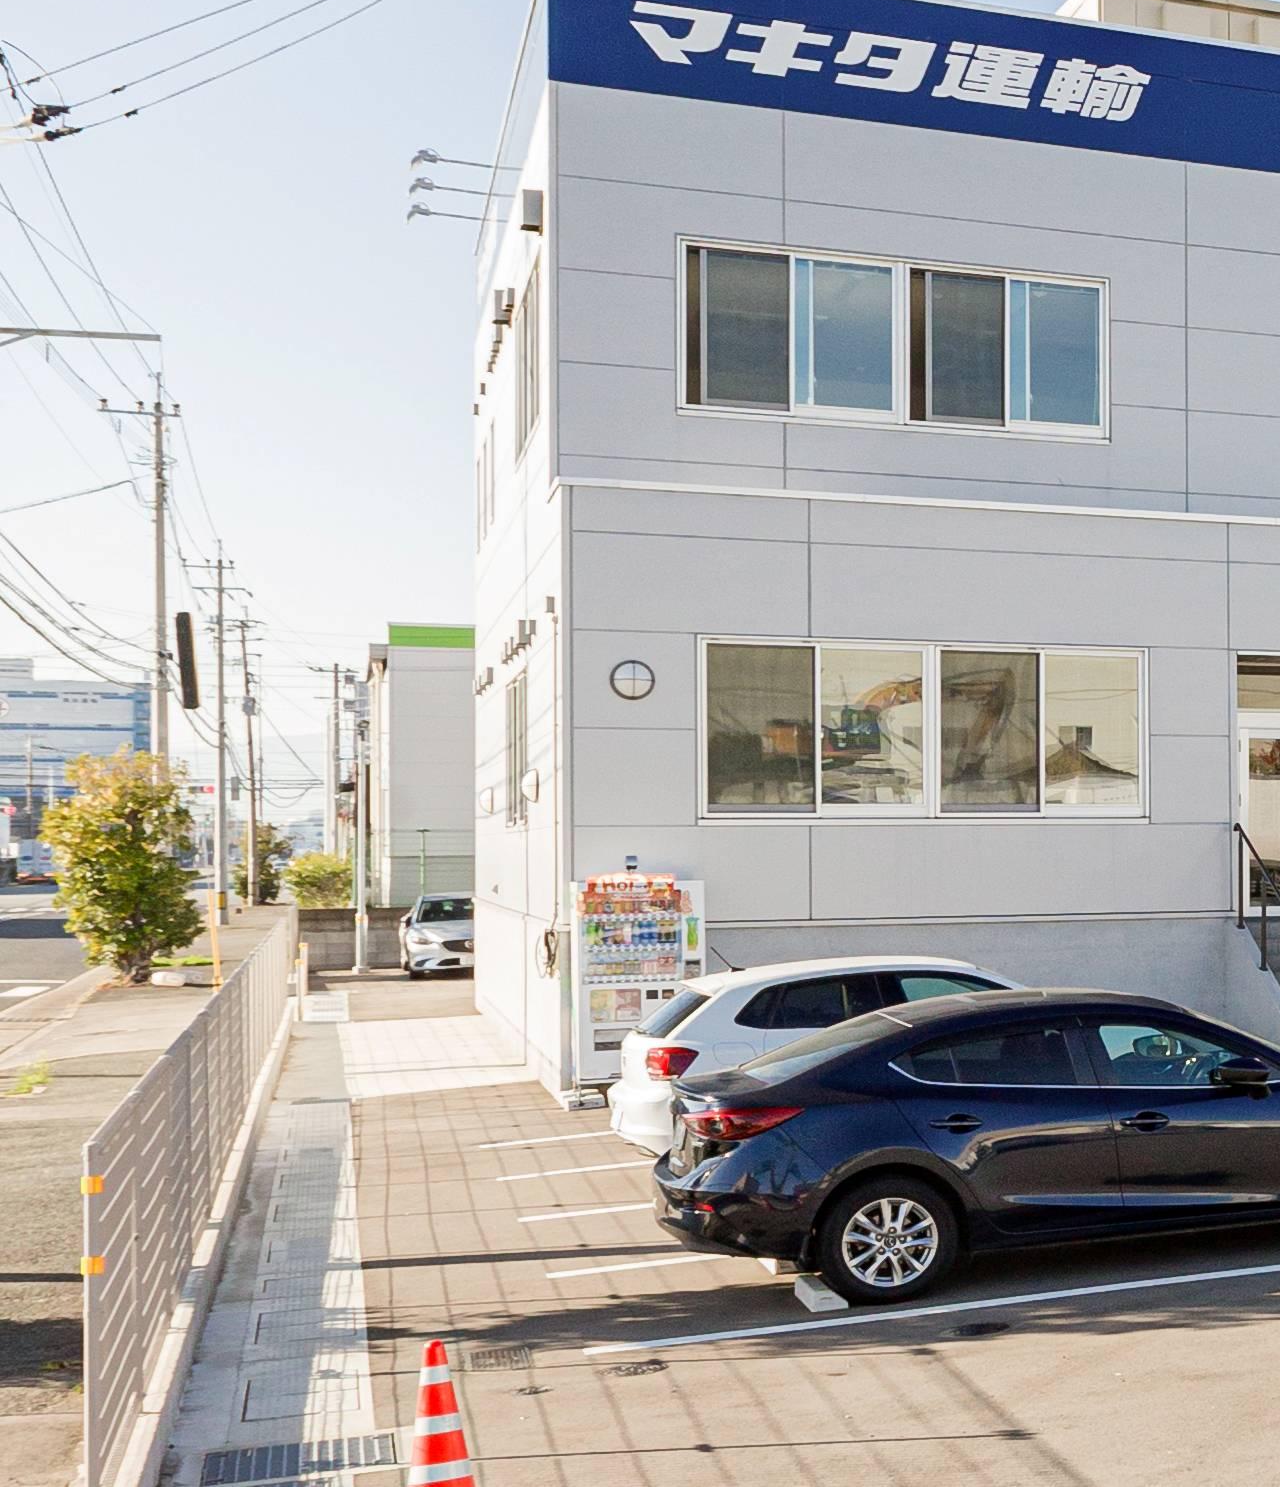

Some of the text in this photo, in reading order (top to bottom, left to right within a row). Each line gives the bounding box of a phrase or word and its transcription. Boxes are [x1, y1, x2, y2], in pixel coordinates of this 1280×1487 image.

[628, 0, 1152, 122] マキタ運輸
